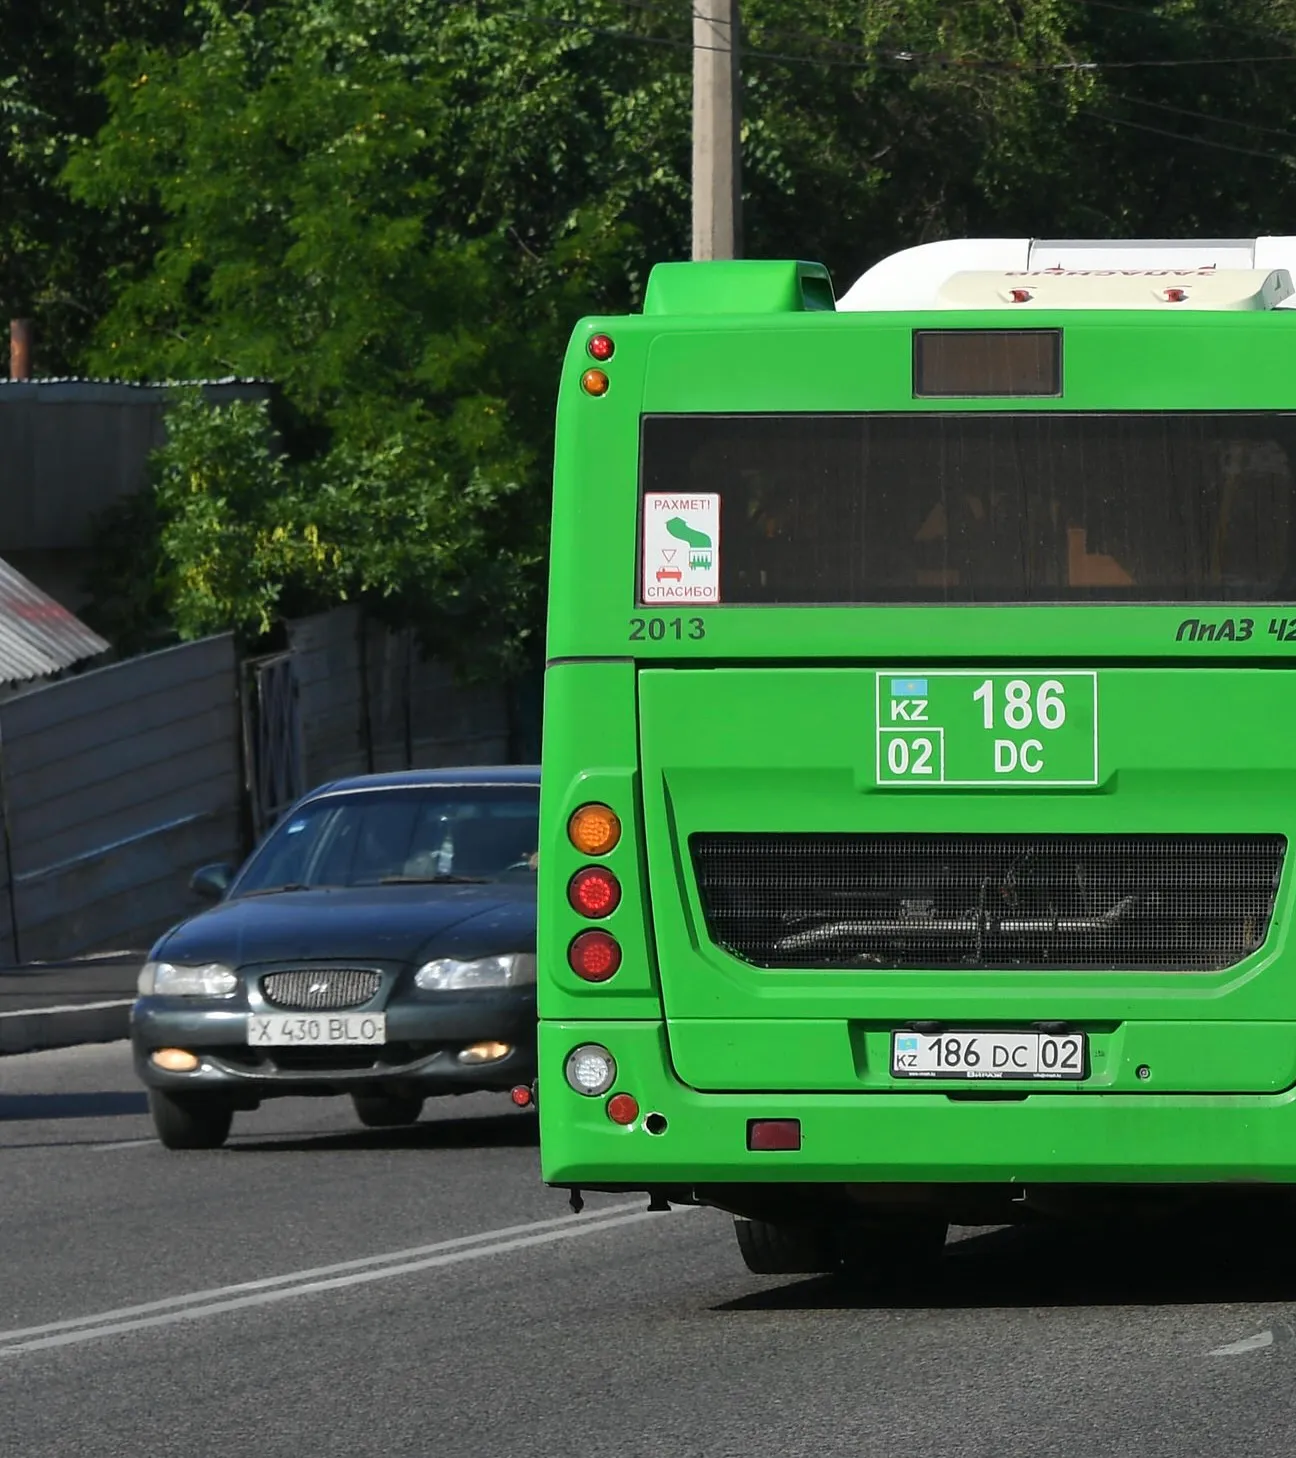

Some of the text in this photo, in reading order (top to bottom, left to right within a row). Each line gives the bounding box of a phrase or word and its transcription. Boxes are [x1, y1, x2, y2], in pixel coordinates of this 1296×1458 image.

[653, 499, 711, 510] РАХМЕТ!
[647, 586, 717, 597] СПАСИБО!
[628, 617, 706, 641] 2013
[890, 699, 929, 721] KZ
[973, 679, 1067, 730] 186
[887, 738, 933, 775] 02
[994, 739, 1045, 774] DC
[258, 1018, 377, 1041] X 430 BLO
[896, 1054, 918, 1067] KZ
[928, 1038, 1078, 1068] 186 DC 02
